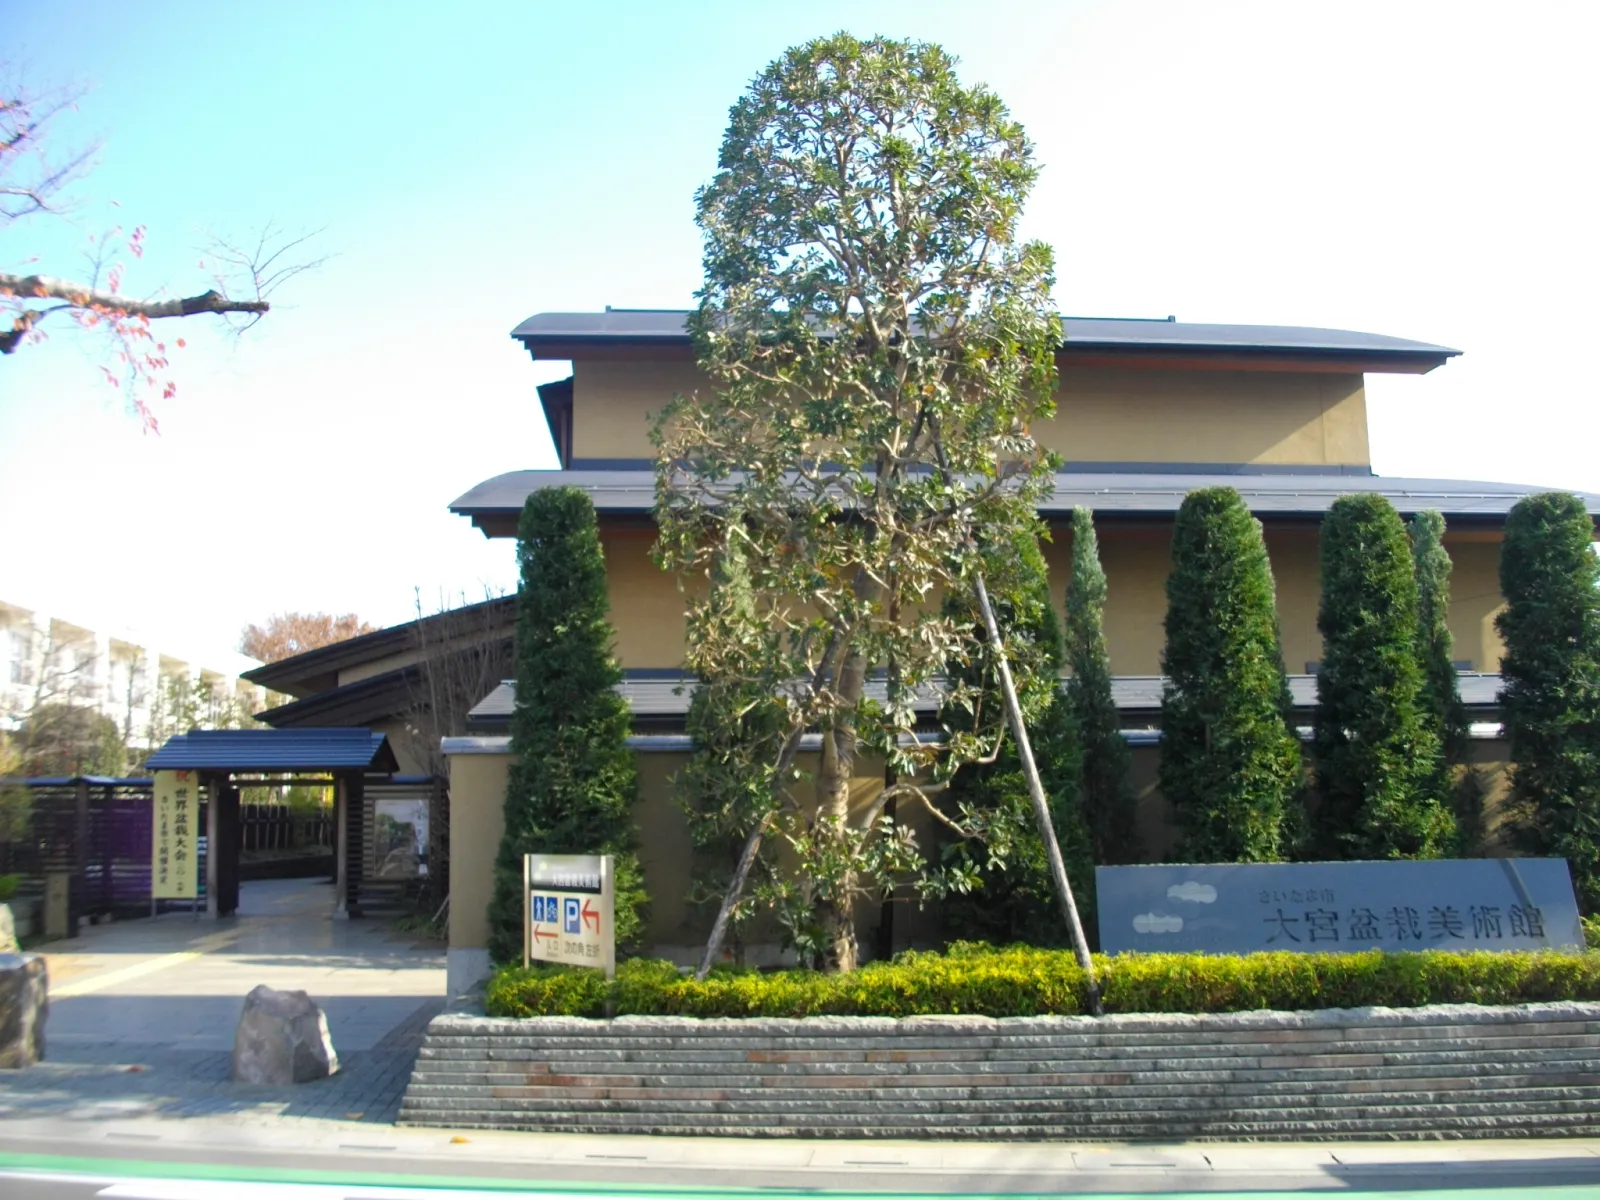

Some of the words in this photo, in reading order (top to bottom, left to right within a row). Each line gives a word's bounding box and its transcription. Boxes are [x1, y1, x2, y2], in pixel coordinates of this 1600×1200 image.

[1258, 888, 1335, 904] さいたま市
[567, 901, 579, 931] P
[1262, 903, 1546, 944] 大宮盆栽美術館
